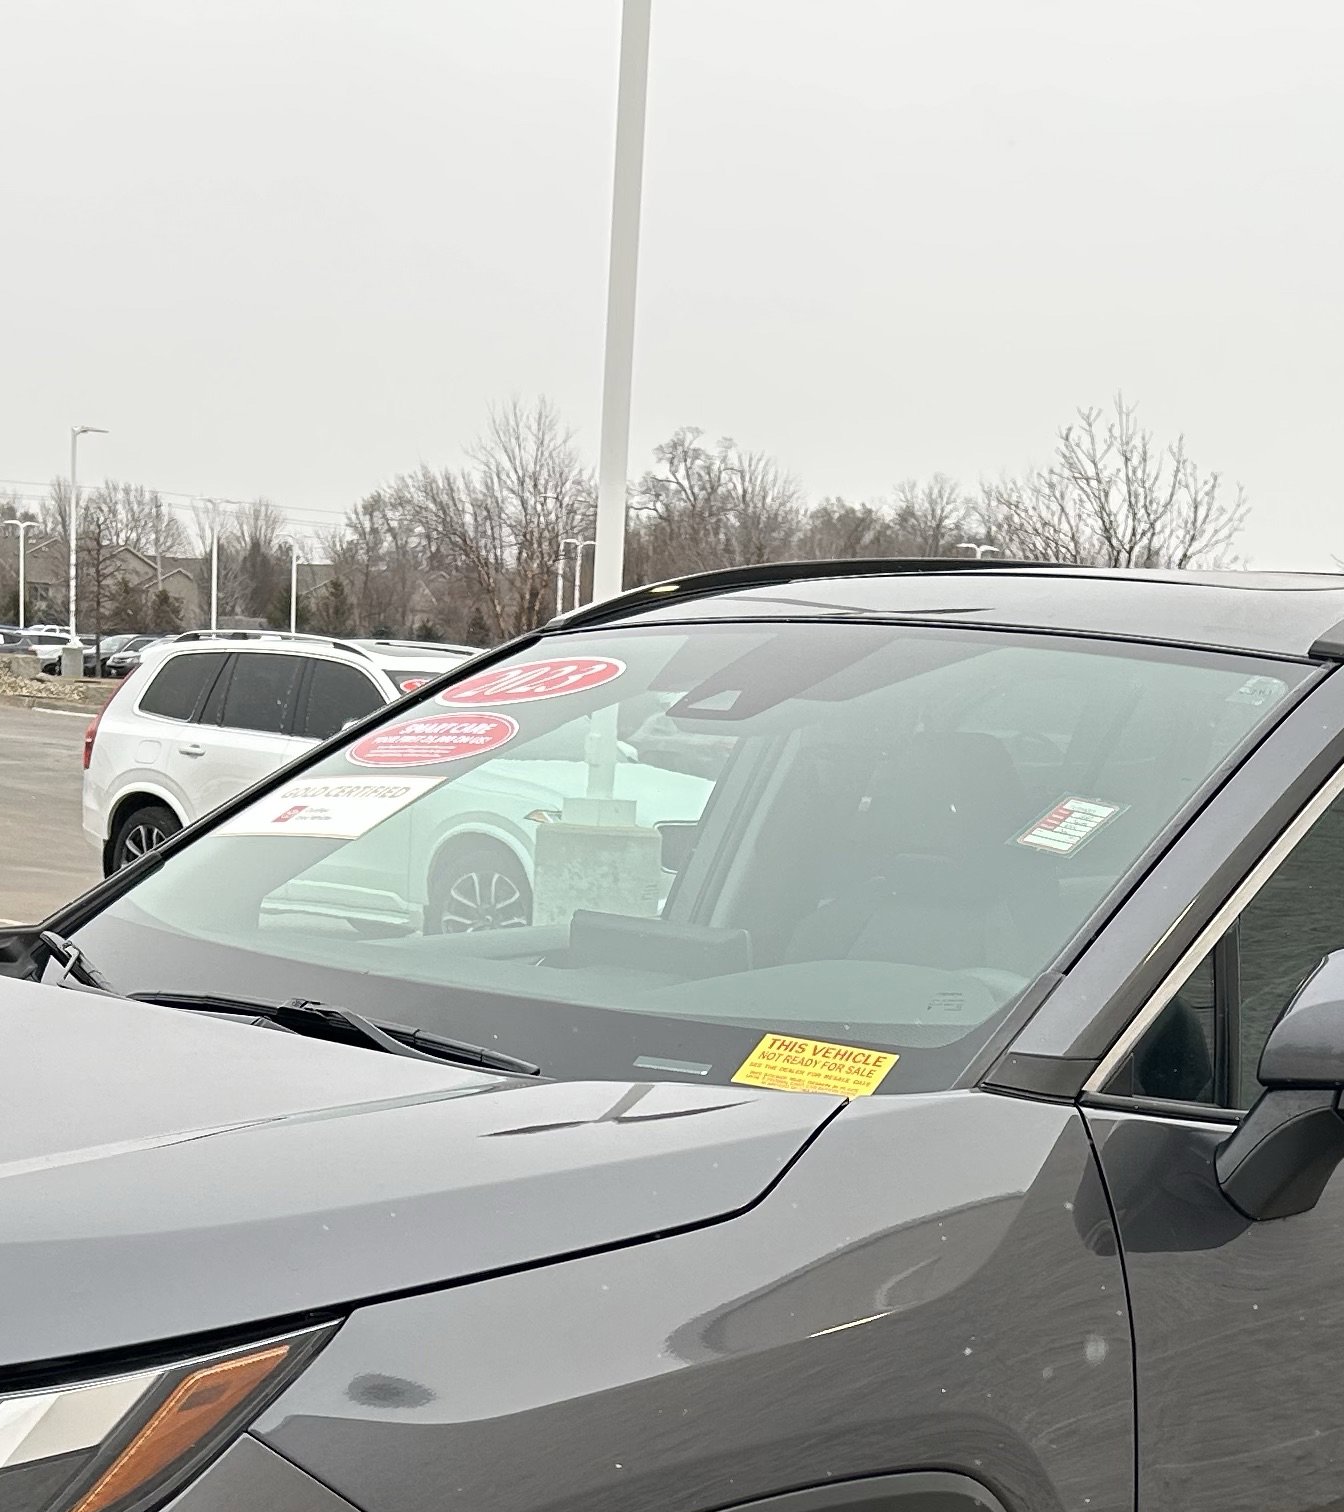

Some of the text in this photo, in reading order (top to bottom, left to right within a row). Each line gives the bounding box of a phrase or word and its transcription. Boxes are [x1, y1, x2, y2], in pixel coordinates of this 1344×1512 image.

[452, 663, 608, 698] 2023
[399, 722, 498, 735] SMART CARE
[281, 786, 412, 799] GOLD CERTIFIED
[767, 1038, 888, 1068] THIS VEHICLE
[758, 1050, 878, 1079] NOT READY FOR SALE
[778, 1066, 806, 1075] DEALER
